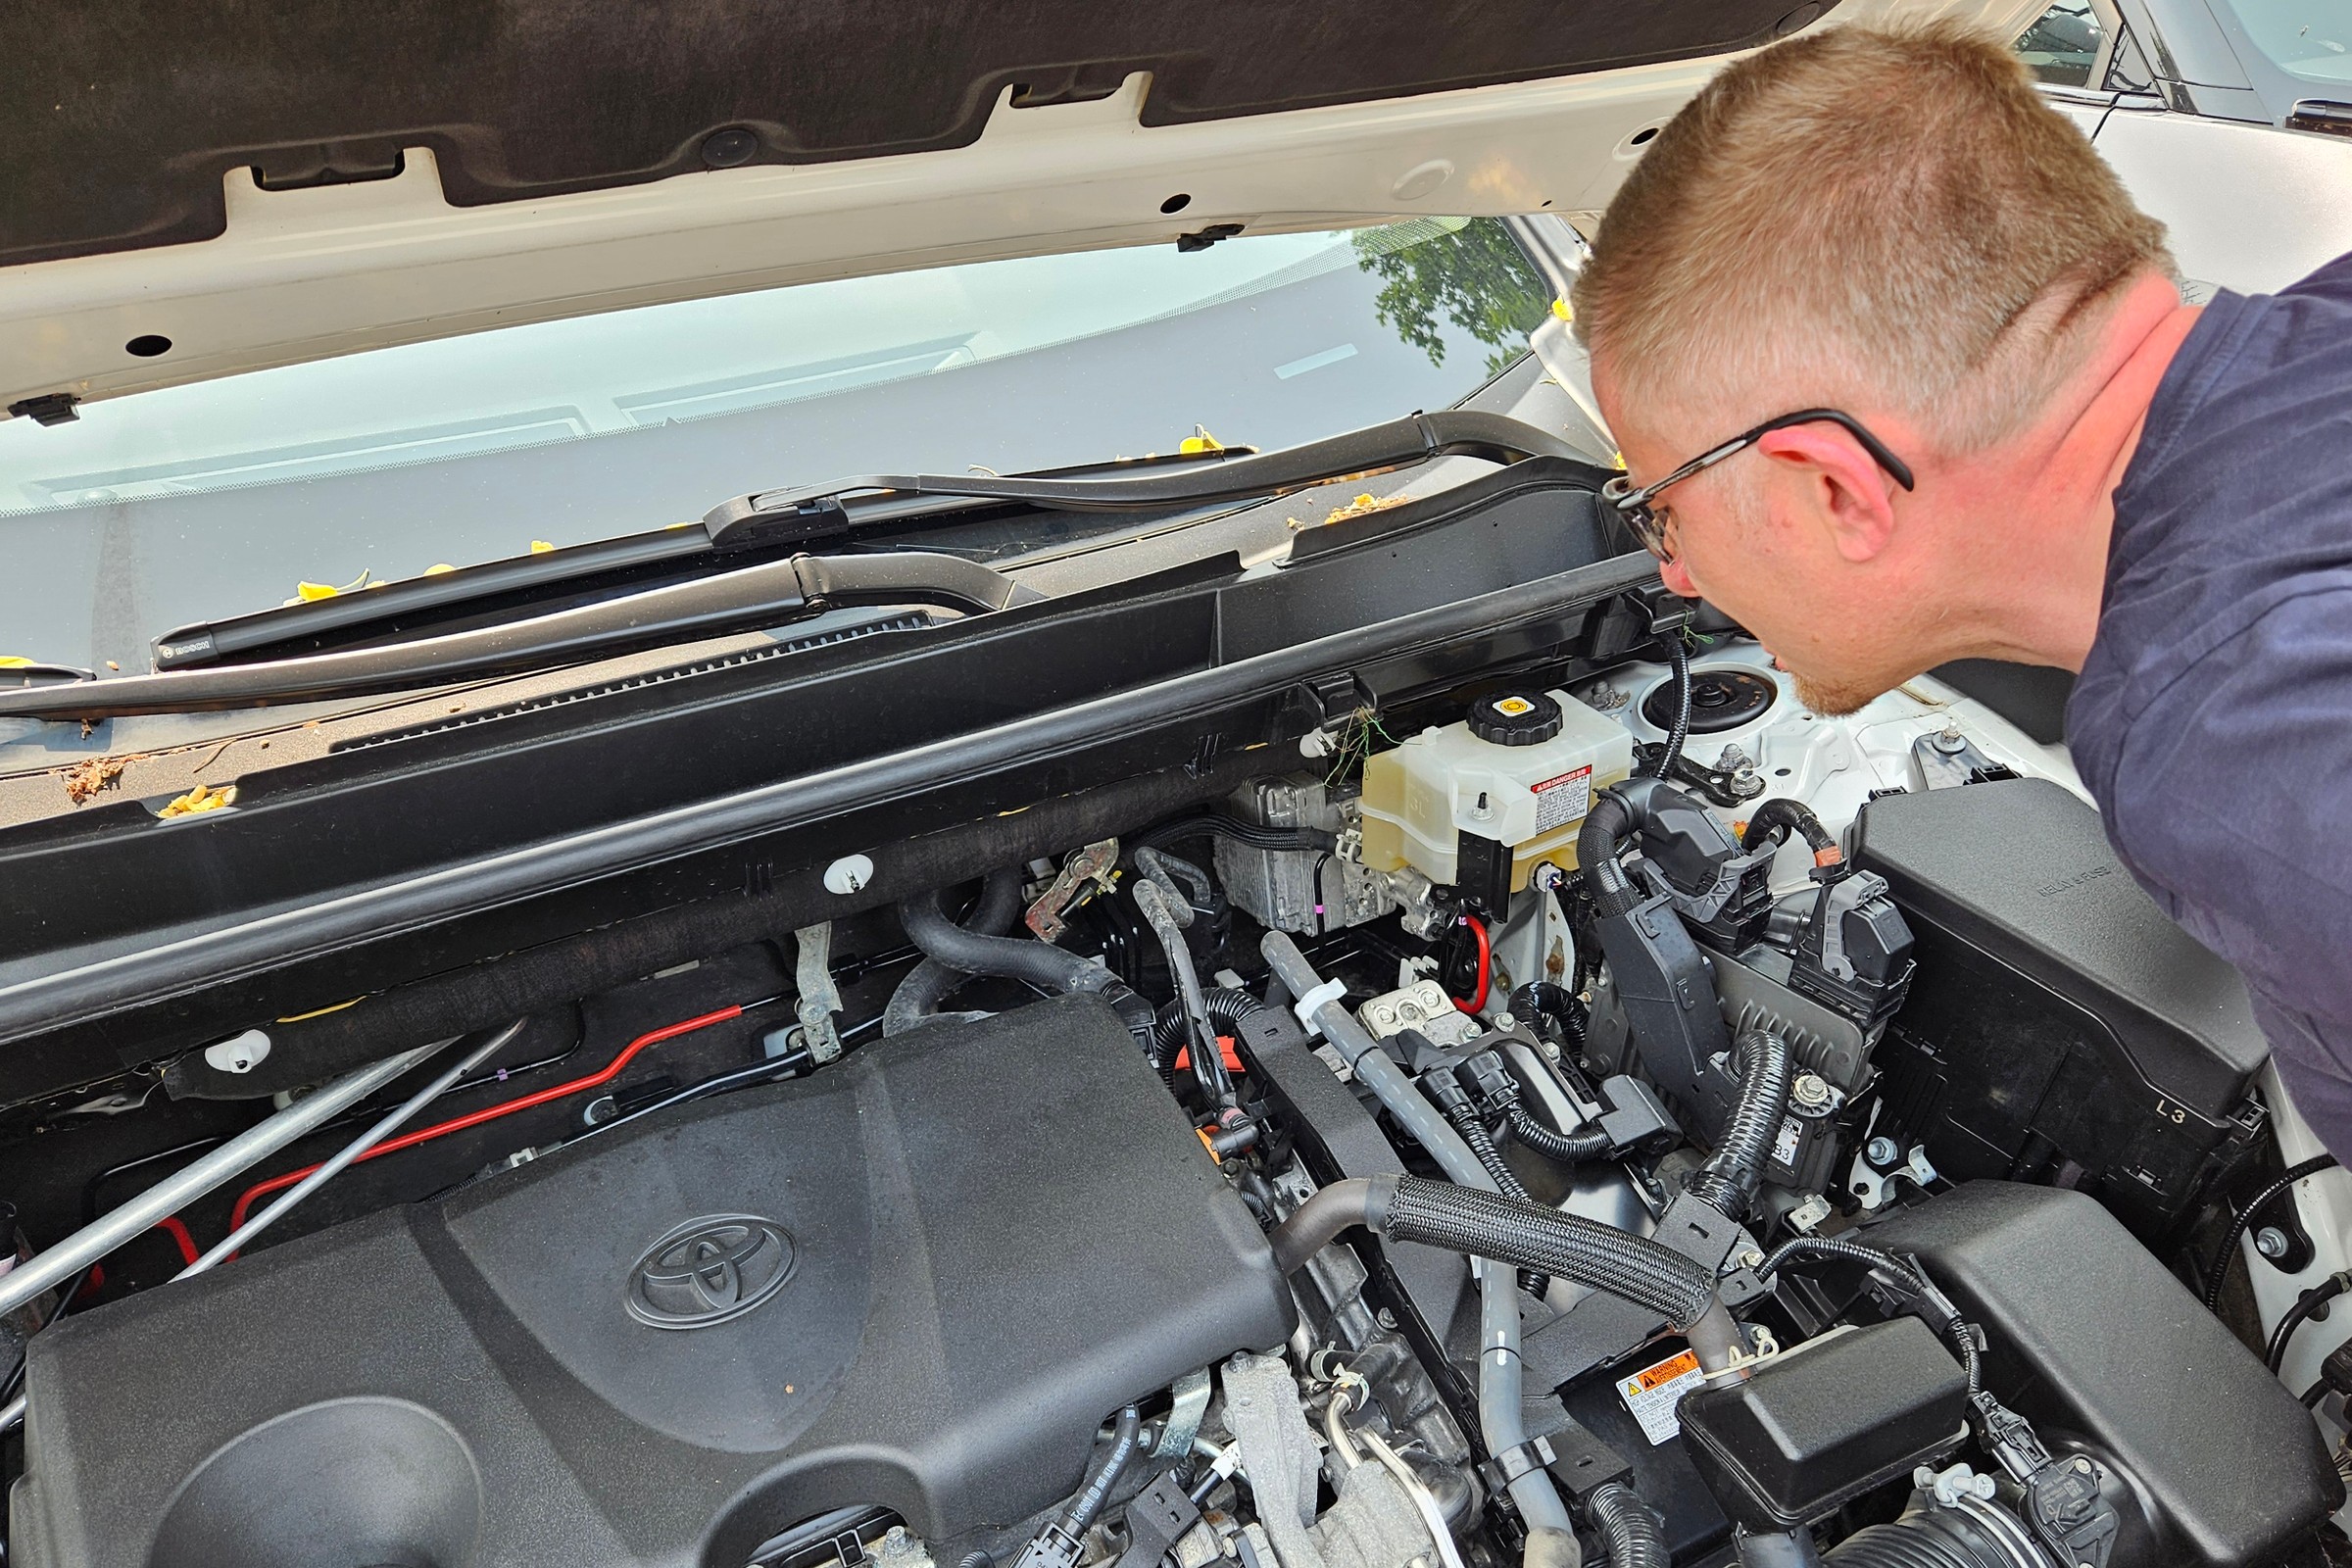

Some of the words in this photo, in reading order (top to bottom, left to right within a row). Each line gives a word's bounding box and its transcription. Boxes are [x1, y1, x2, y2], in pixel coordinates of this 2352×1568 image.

[175, 641, 210, 656] BOSCH
[1551, 772, 1577, 785] DANGER
[1649, 1358, 1678, 1377] WARNING
